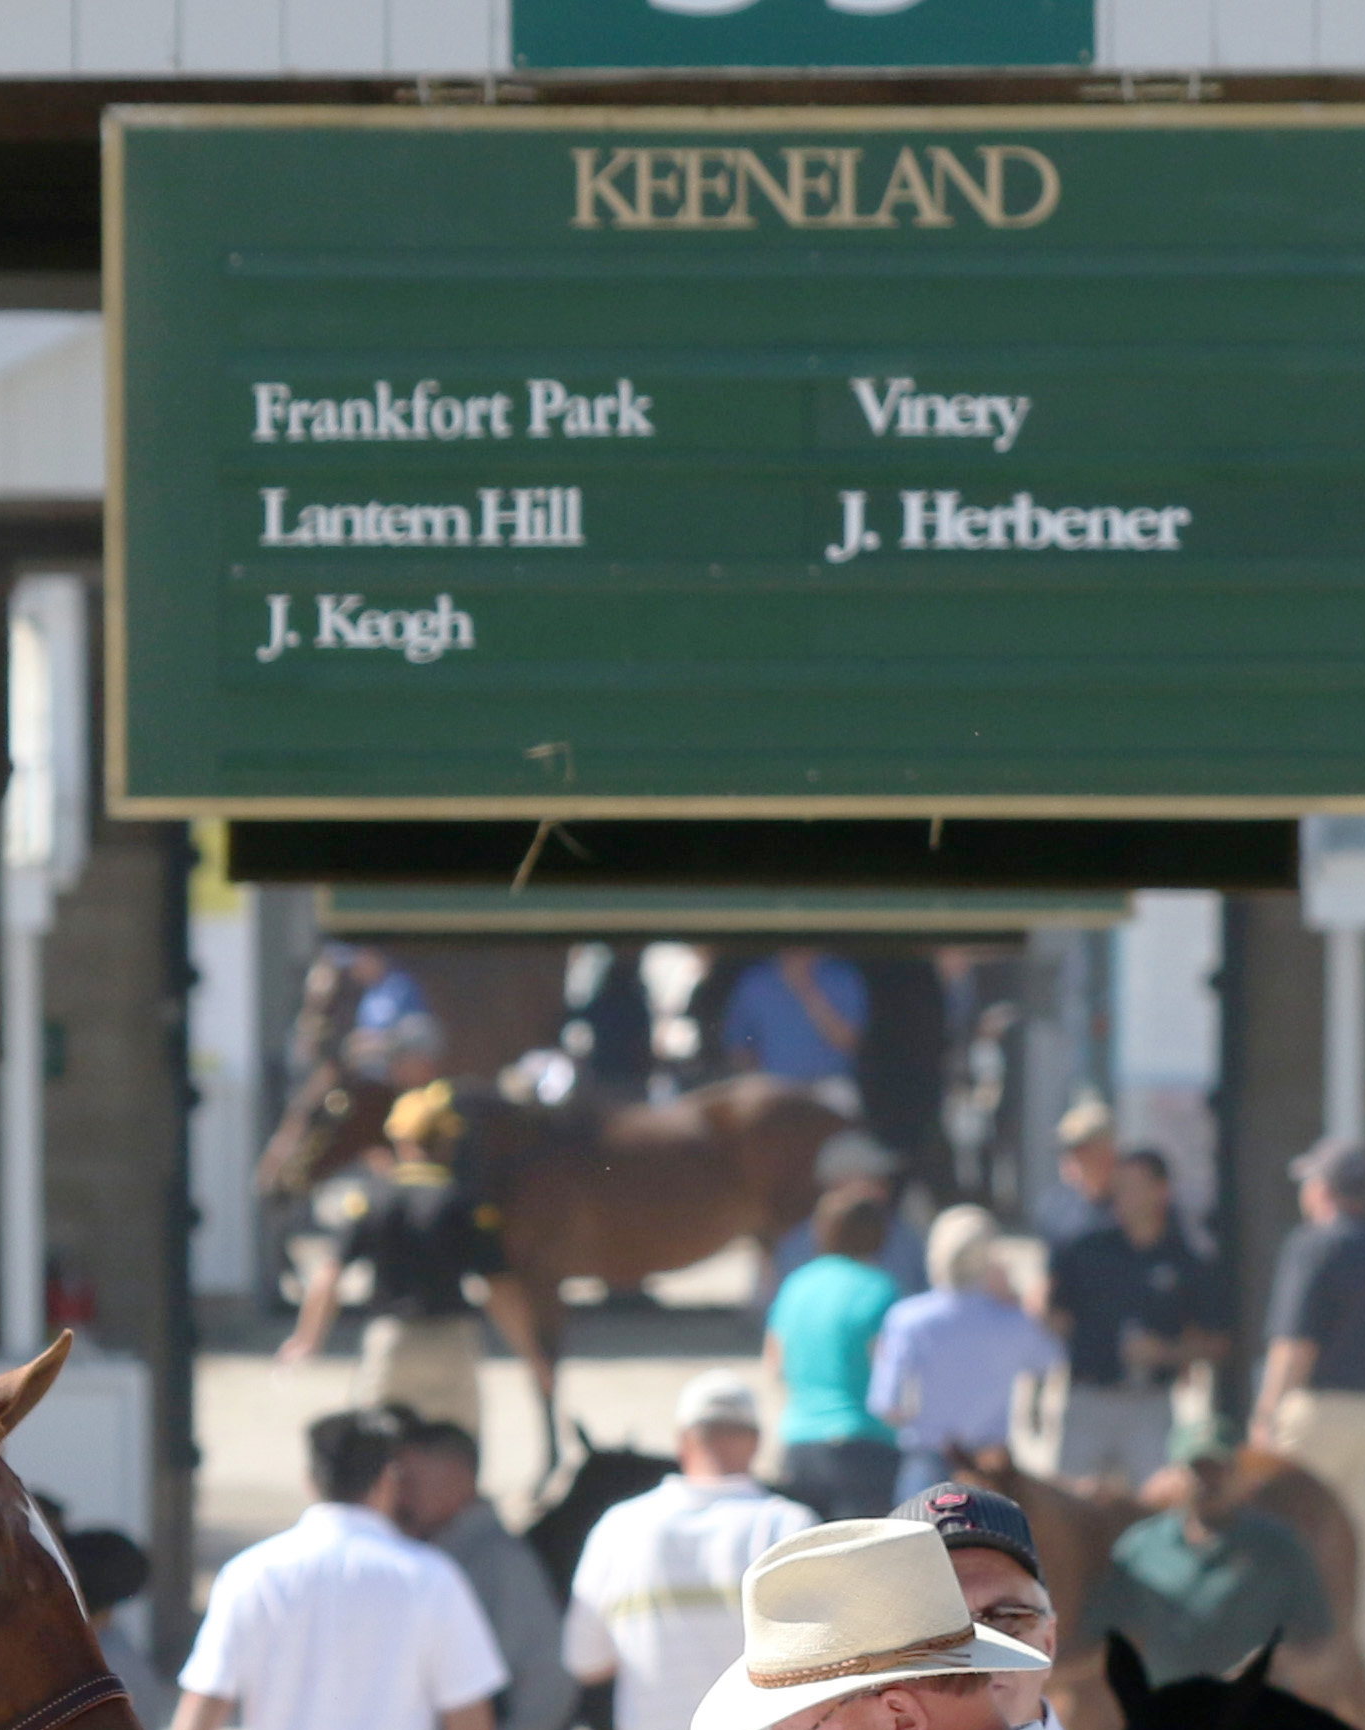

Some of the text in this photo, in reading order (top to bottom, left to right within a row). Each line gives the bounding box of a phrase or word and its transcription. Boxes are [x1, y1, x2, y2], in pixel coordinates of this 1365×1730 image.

[569, 145, 1061, 230] KEENELAND
[251, 376, 656, 443] Frankfort Park
[849, 376, 1031, 453] Vinery
[259, 485, 586, 547] Lantern Hill
[824, 490, 1192, 564] J. Herbener
[255, 593, 476, 664] J. Keogh
